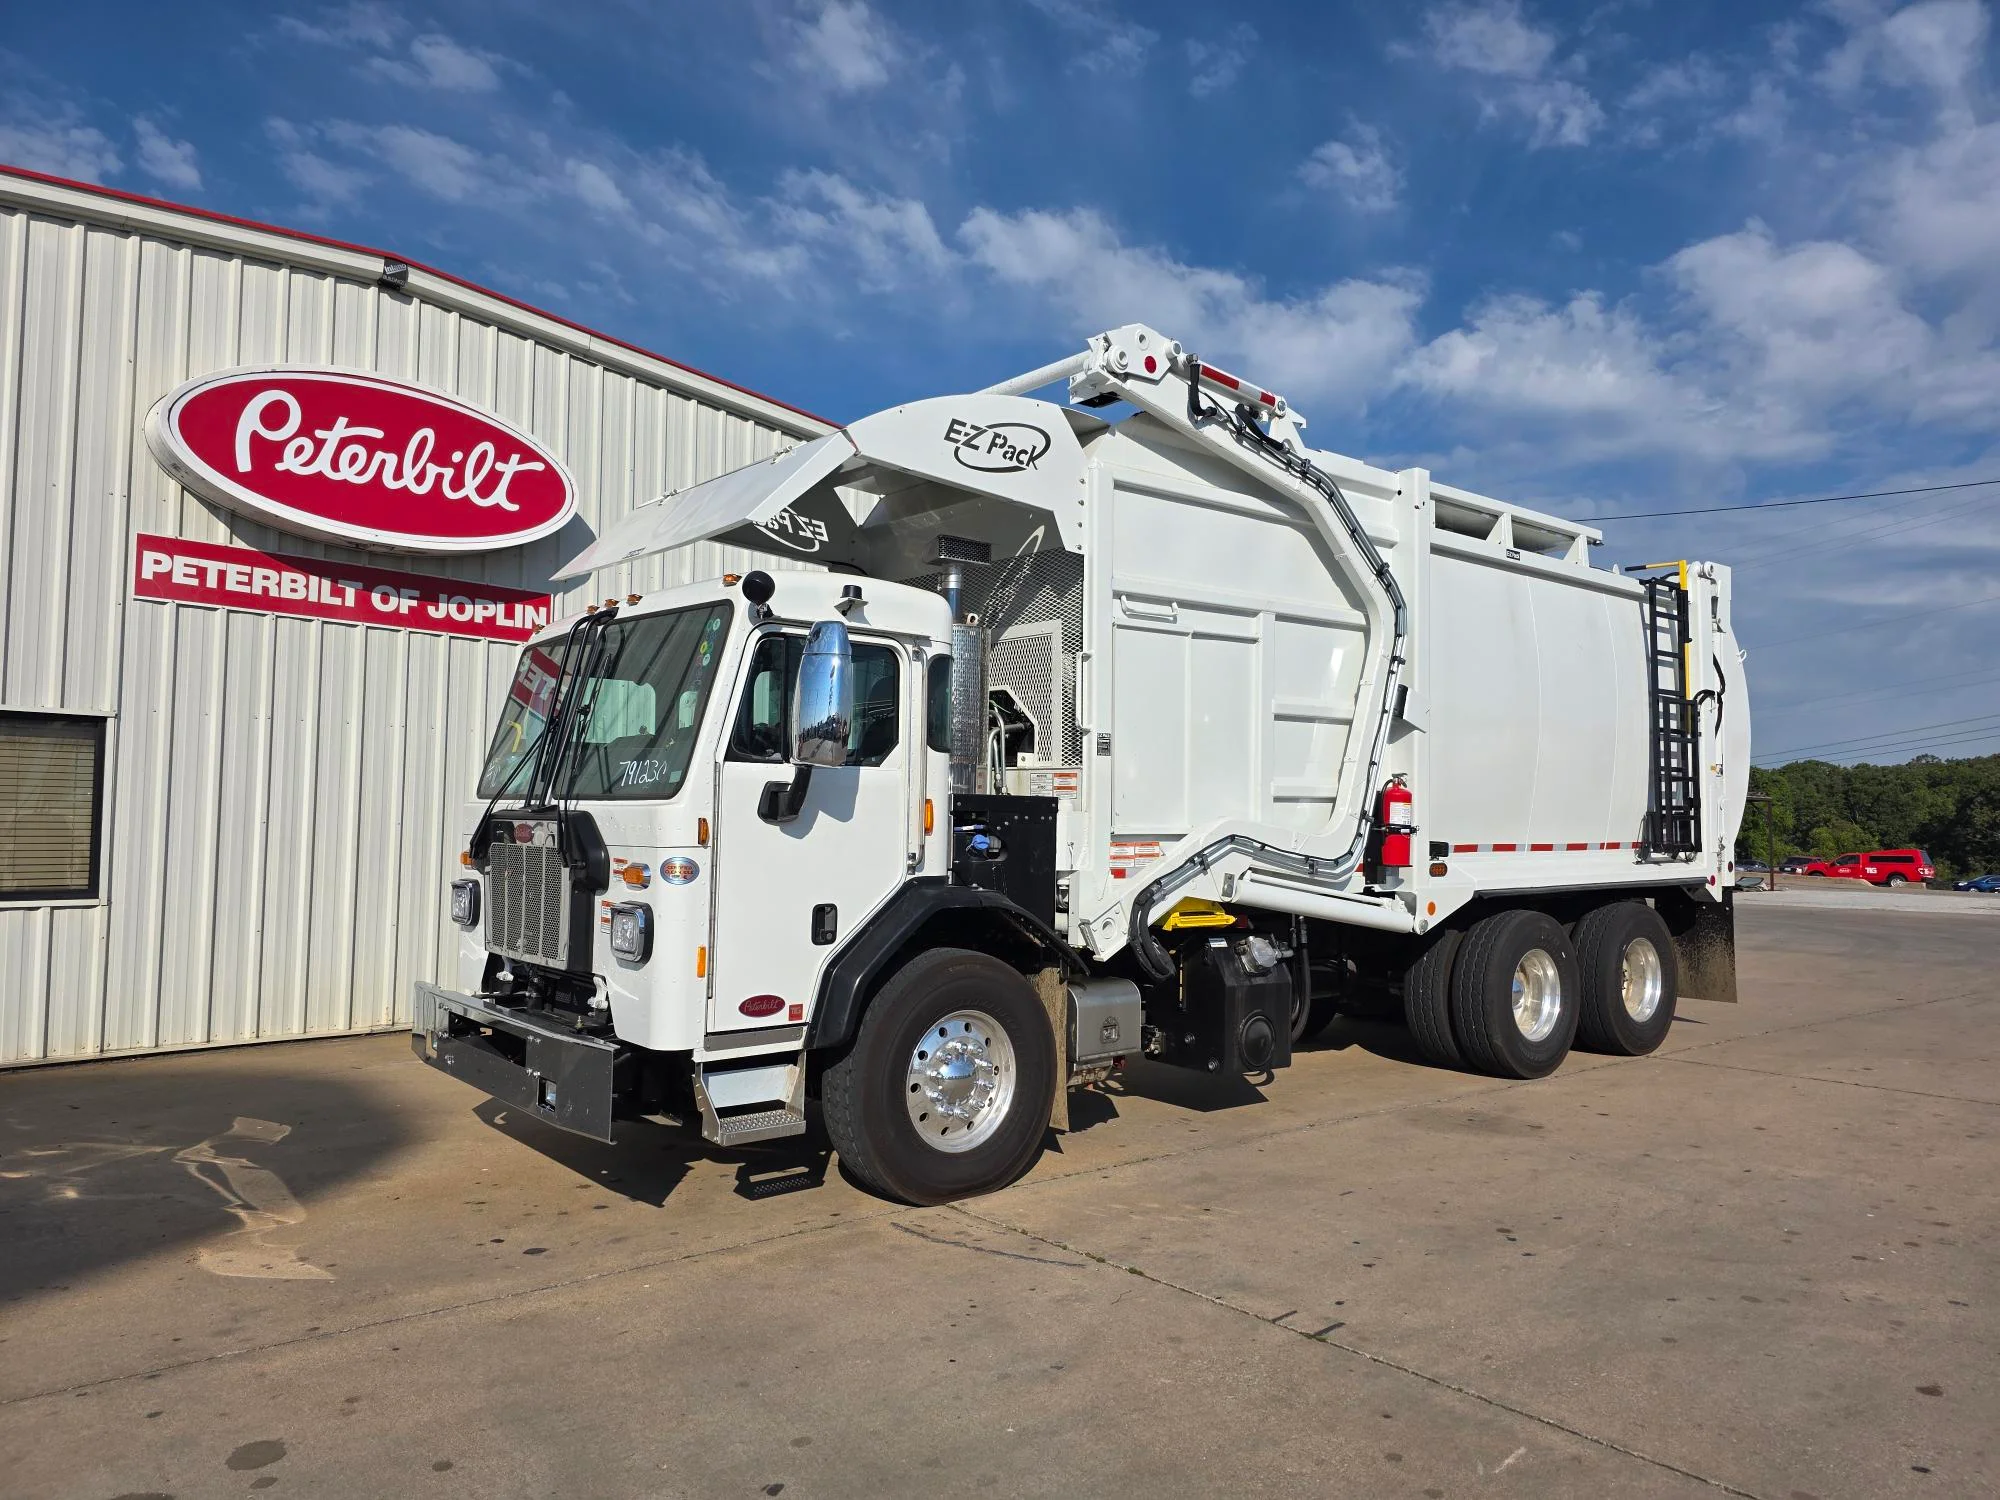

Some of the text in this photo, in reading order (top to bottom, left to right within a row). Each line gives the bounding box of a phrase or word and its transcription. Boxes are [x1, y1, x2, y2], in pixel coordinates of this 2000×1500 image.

[235, 389, 545, 512] Peterbilt
[986, 431, 1039, 471] Pack
[141, 550, 547, 630] PETERBILT OF JOPLIN
[744, 999, 781, 1013] Peterbilt
